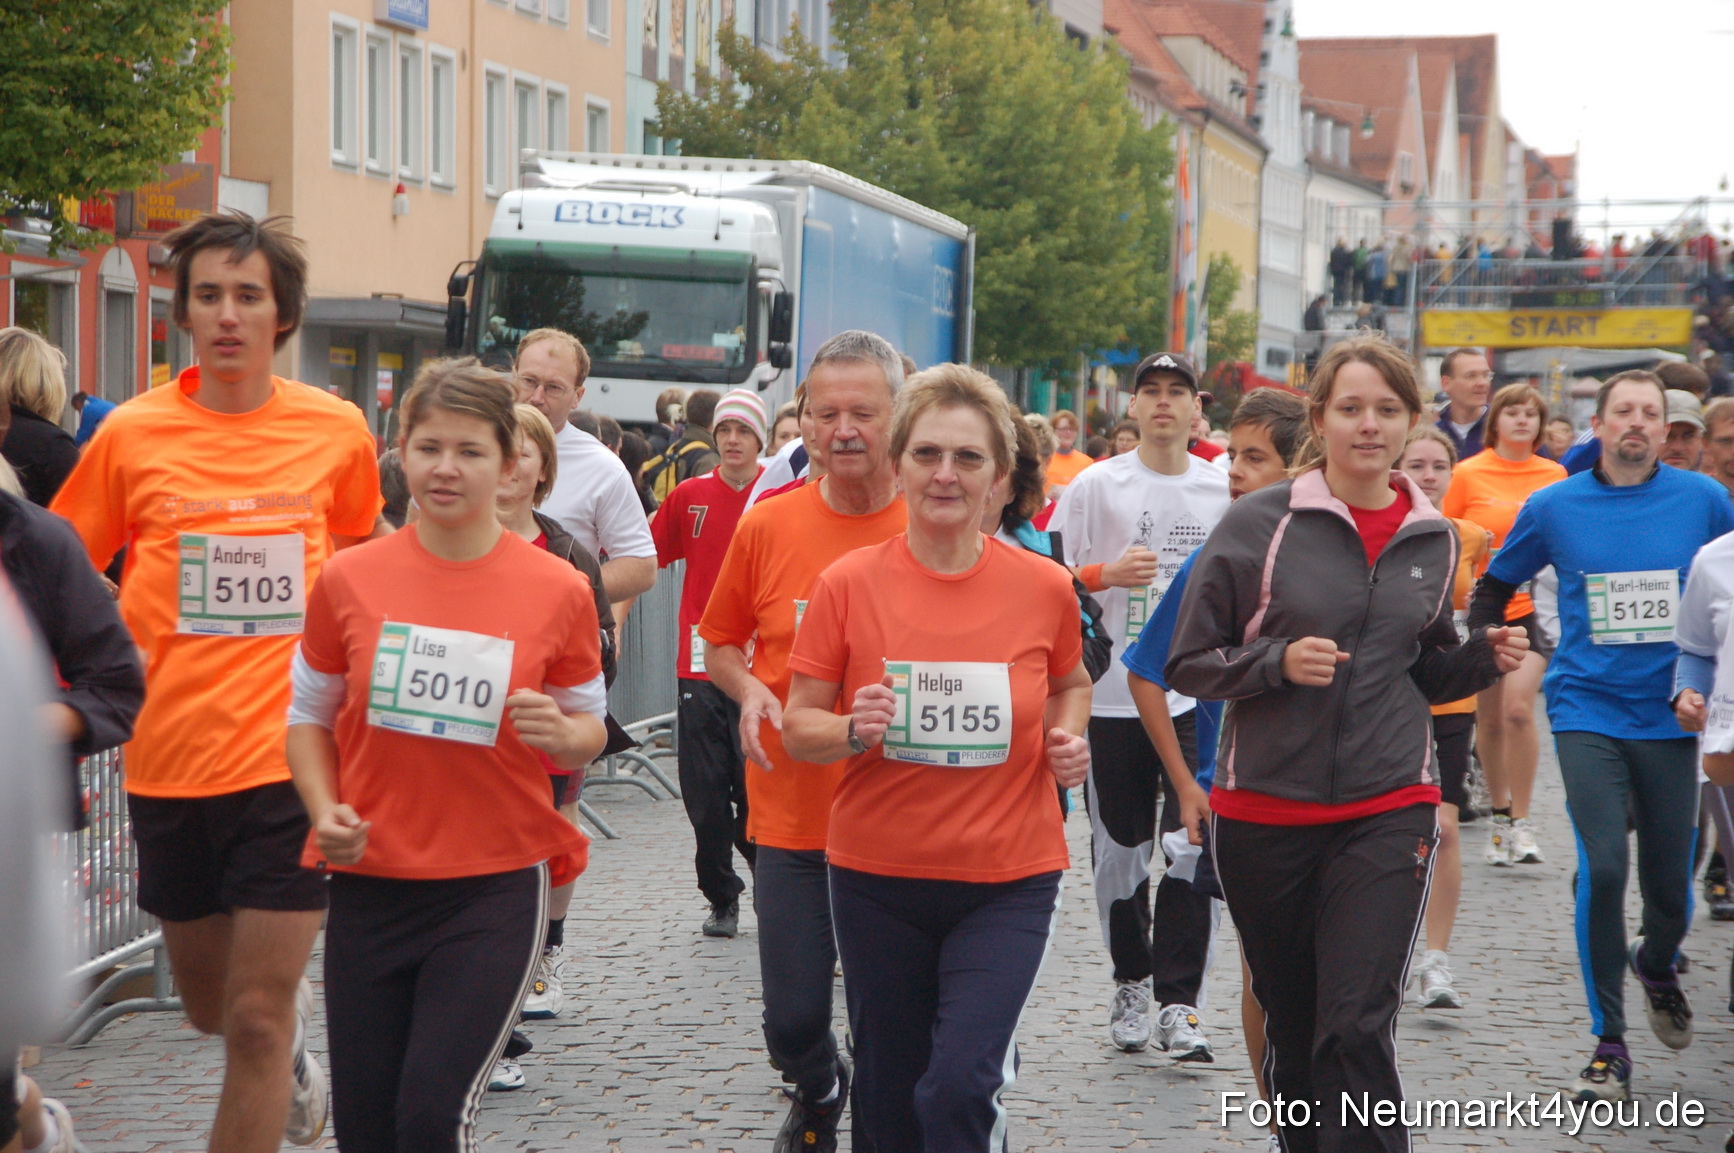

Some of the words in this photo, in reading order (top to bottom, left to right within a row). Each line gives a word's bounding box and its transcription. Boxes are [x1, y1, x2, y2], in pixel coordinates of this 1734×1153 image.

[148, 194, 175, 206] DER
[554, 200, 686, 228] BOCK
[1510, 315, 1600, 337] START
[183, 499, 224, 513] stark
[228, 492, 313, 511] ausbildung
[688, 505, 708, 538] 7
[213, 545, 267, 568] Andrej
[184, 572, 192, 586] S
[215, 575, 293, 604] 5103
[1610, 578, 1671, 593] Karl-Heinz
[1151, 587, 1166, 601] Pa
[1131, 606, 1137, 616] S
[1614, 599, 1671, 621] 5128
[413, 635, 447, 658] Lisa
[377, 661, 386, 677] S
[408, 668, 493, 708] 5010
[918, 672, 963, 696] Helga
[920, 704, 1001, 732] 5155
[448, 722, 495, 738] PFLEIDERER
[962, 749, 1007, 760] PFLEIDERER
[535, 982, 545, 991] S
[804, 1131, 816, 1144] S
